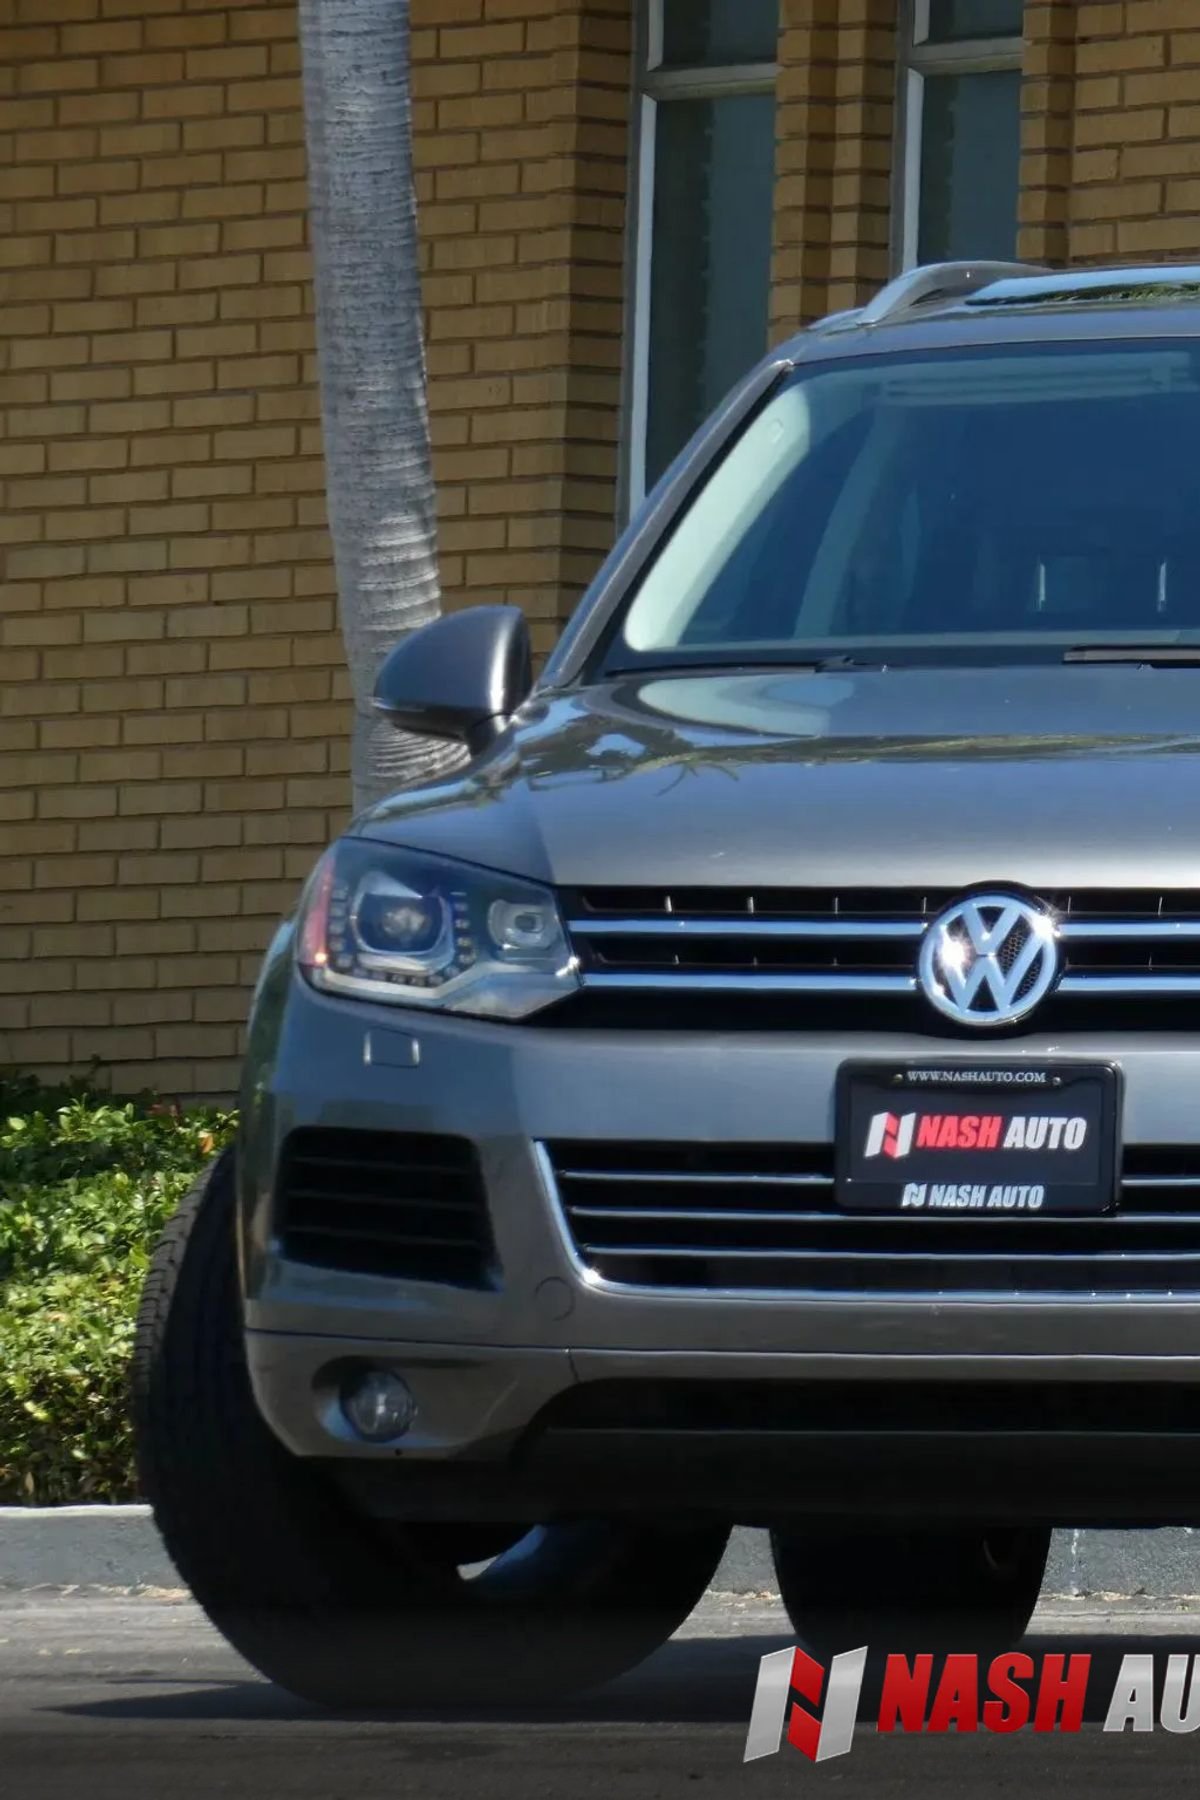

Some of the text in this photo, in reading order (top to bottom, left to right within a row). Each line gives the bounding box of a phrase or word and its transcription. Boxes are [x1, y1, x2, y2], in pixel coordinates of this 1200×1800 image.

[907, 1071, 1046, 1083] WWW.NASHAUTO.COM
[916, 1115, 1002, 1148] NASH
[1003, 1116, 1087, 1150] AUTO
[929, 1184, 985, 1207] NASH
[987, 1185, 1044, 1208] AUTO
